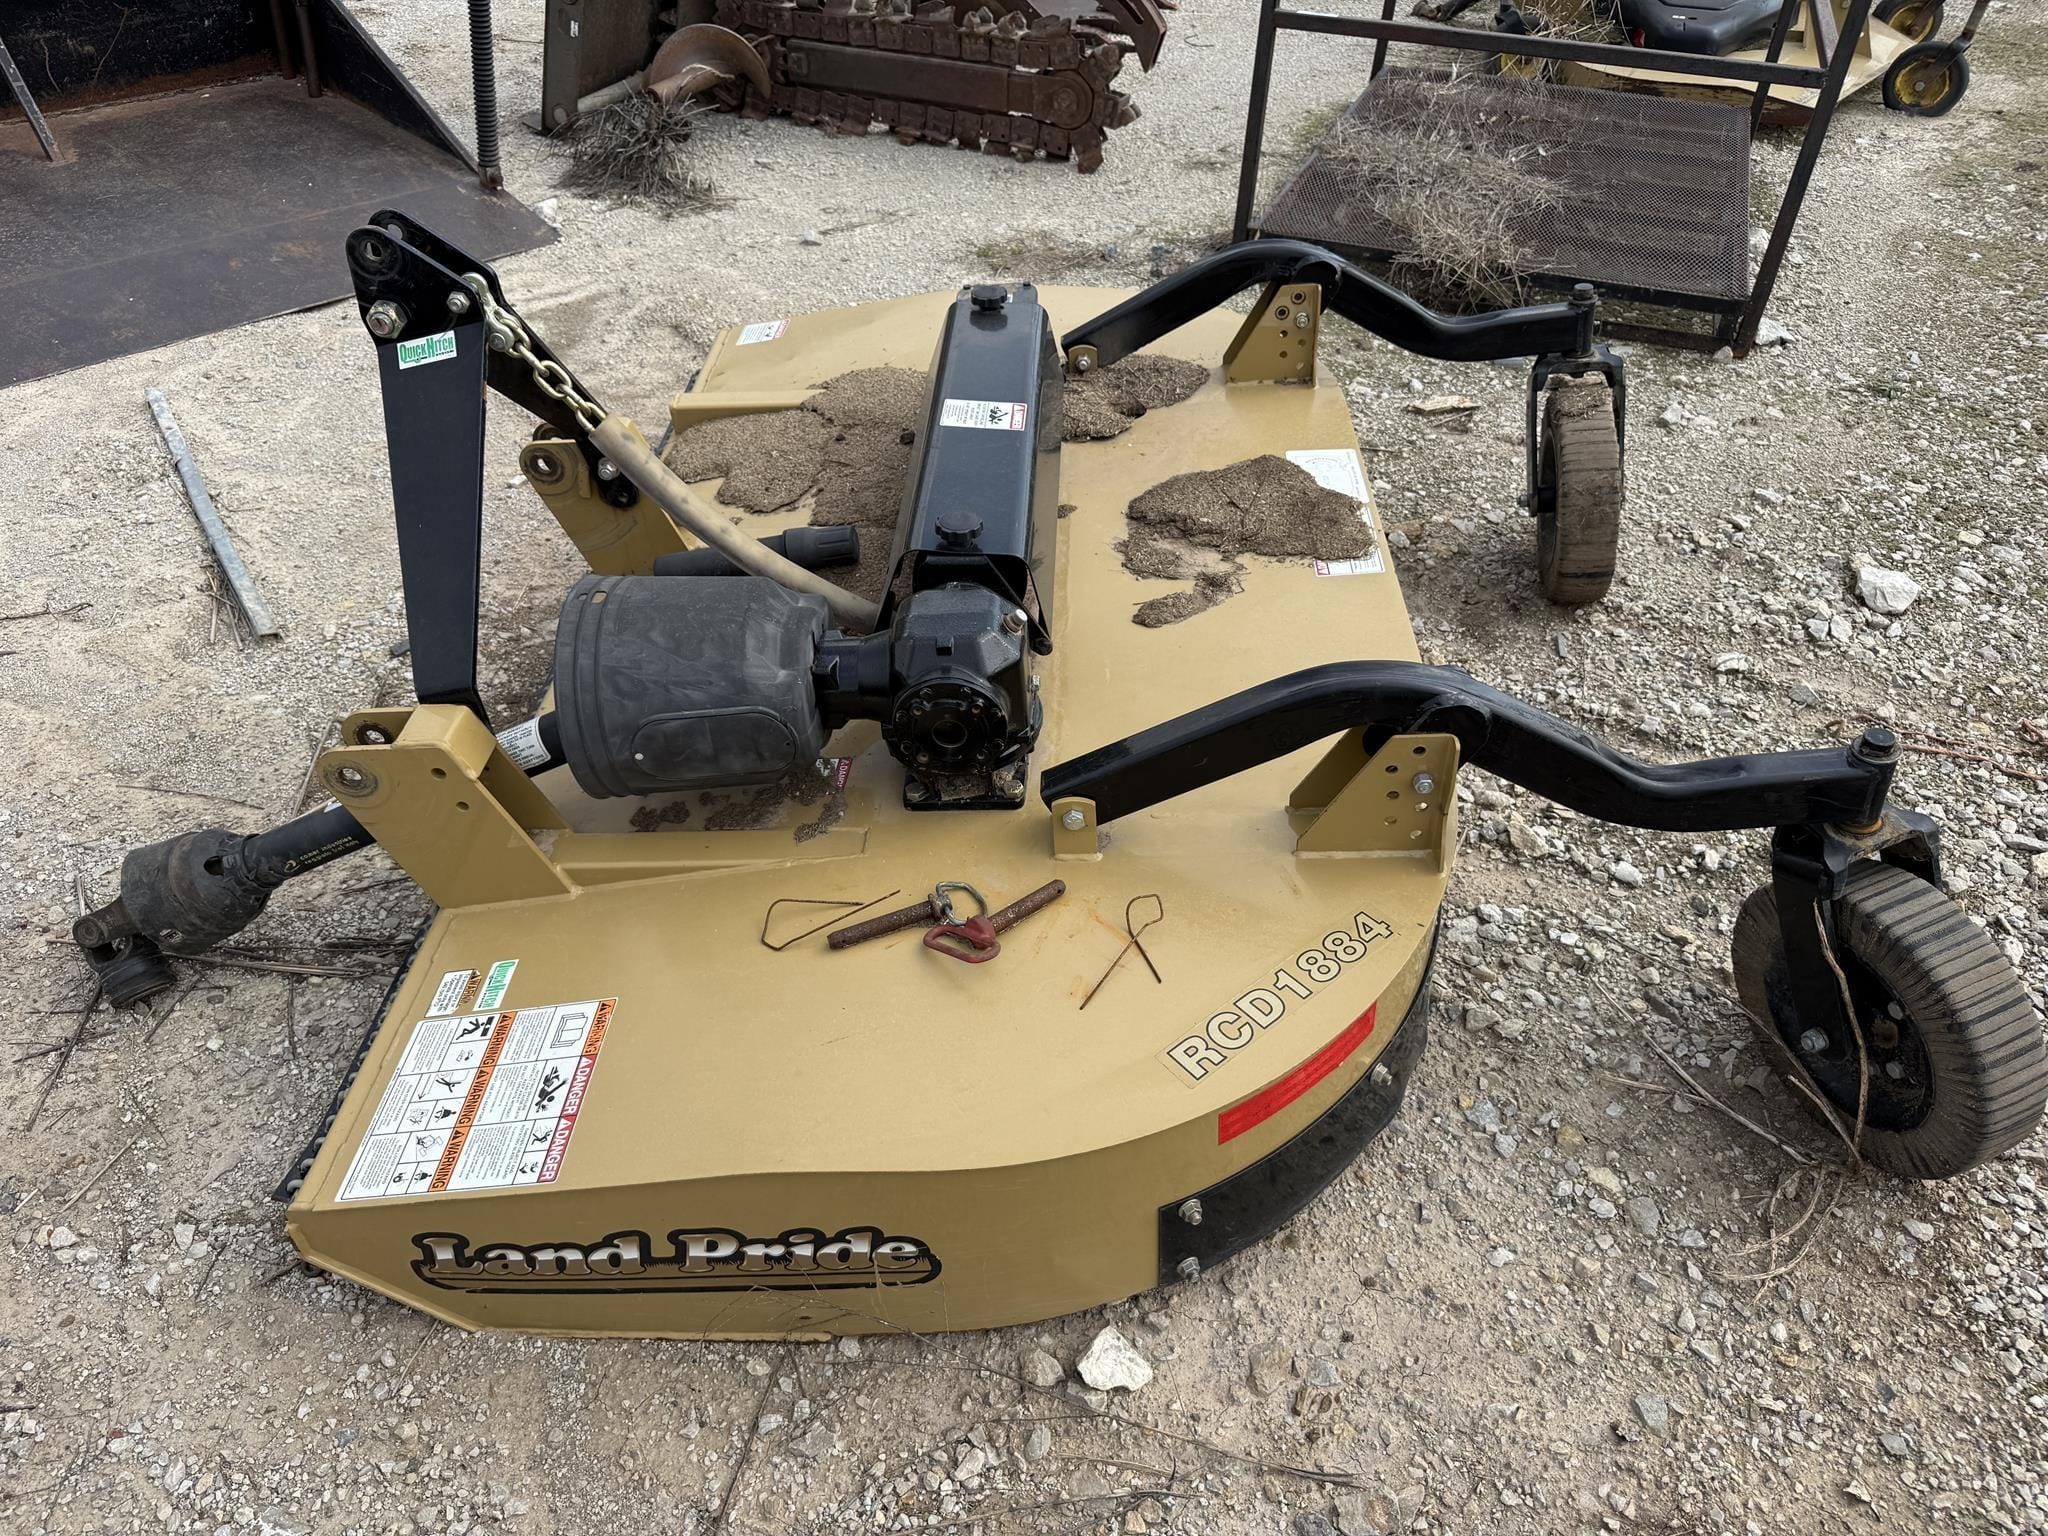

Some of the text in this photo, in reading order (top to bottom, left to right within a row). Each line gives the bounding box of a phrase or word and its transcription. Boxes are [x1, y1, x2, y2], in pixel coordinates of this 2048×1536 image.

[1166, 911, 1394, 1081] RCD1884
[482, 1024, 508, 1065] WARNING
[584, 1011, 608, 1053] WARNING
[457, 1079, 485, 1124] WARNING
[563, 1067, 590, 1113] DANGER
[431, 1140, 461, 1188] WARNING
[540, 1129, 569, 1180] DANGER
[418, 1229, 920, 1276] Land Pride
